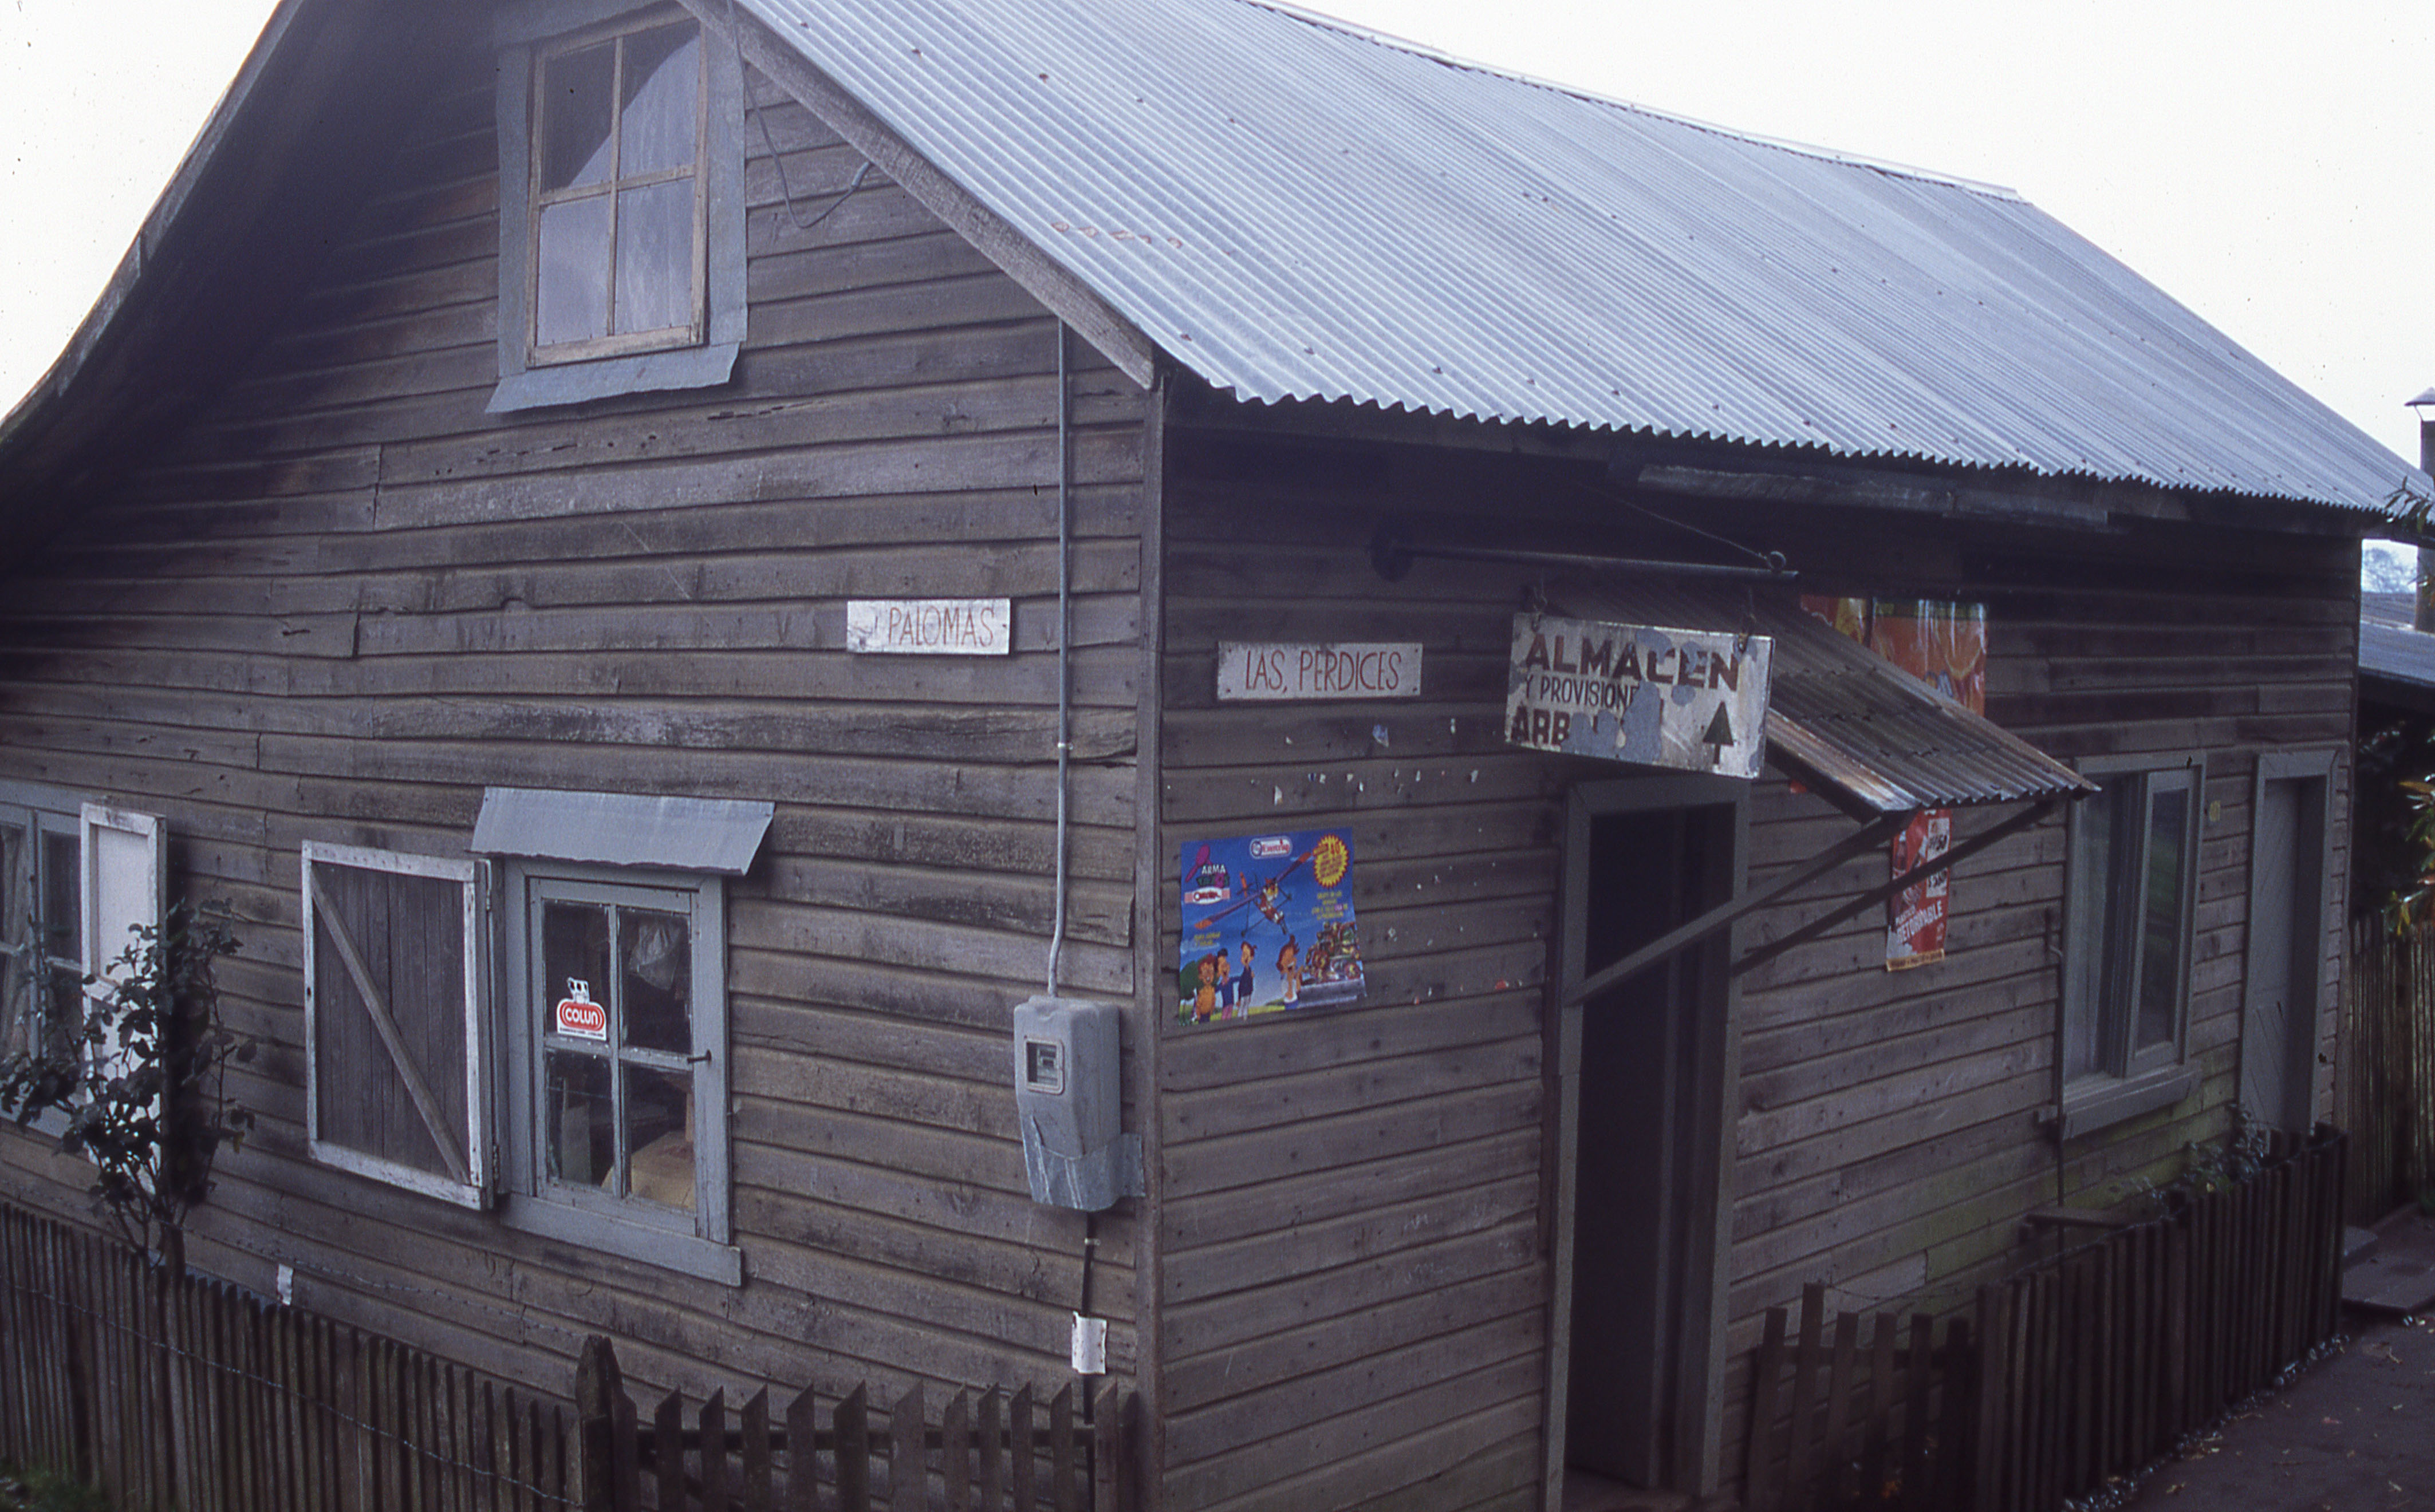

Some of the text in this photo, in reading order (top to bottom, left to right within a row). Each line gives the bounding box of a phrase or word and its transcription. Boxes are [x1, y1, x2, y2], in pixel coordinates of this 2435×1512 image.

[888, 606, 995, 648] PALOMAS
[1299, 649, 1402, 691] PERDICES
[1525, 632, 1739, 692] ALMACEN
[1524, 674, 1534, 699] Y
[1201, 864, 1226, 875] ARMA
[565, 1008, 598, 1026] COLUN
